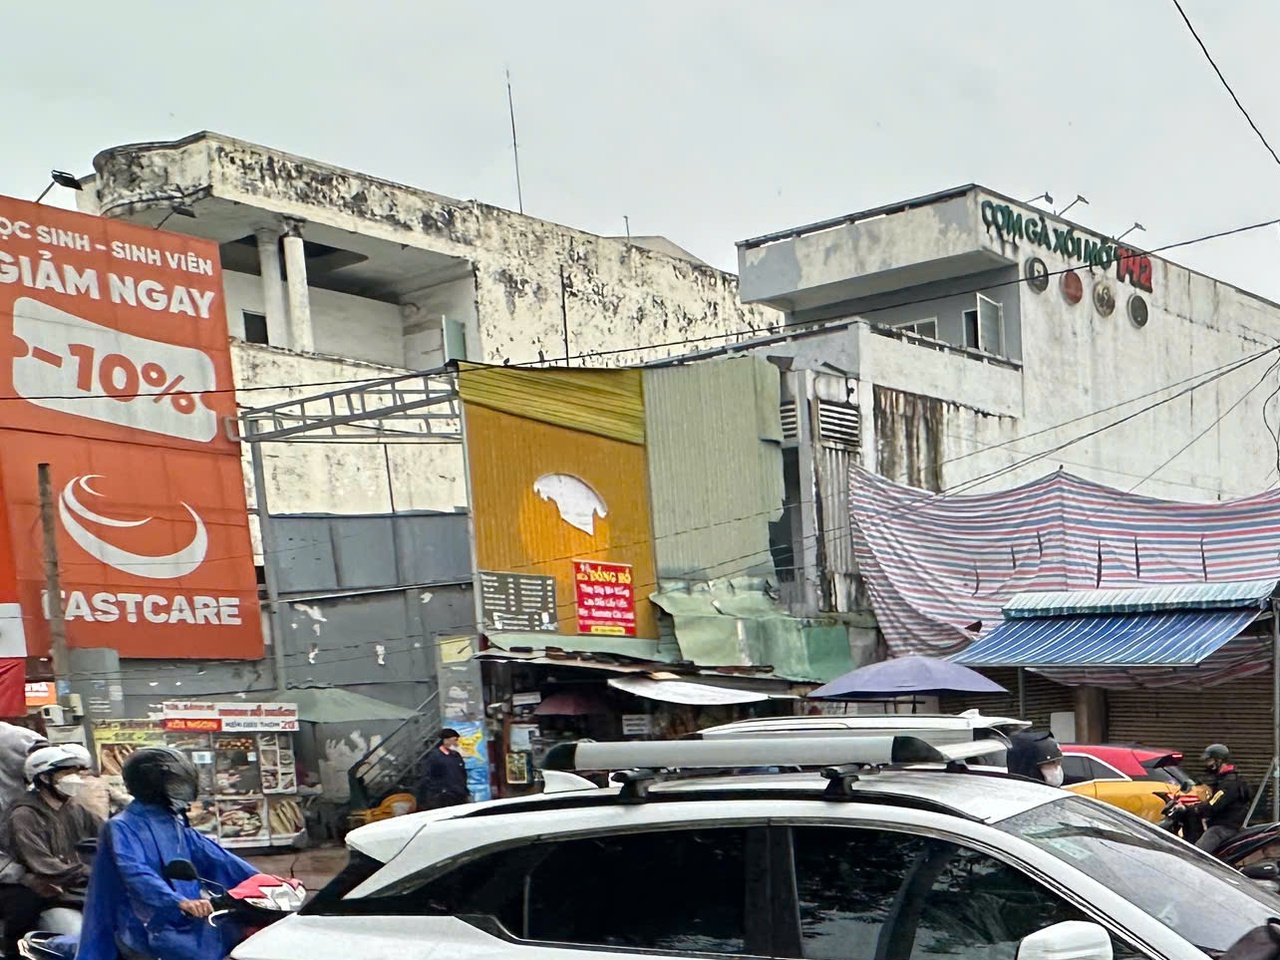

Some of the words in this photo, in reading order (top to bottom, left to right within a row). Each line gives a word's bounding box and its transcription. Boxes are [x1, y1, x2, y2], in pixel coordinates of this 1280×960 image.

[36, 225, 91, 252] SINH
[111, 240, 162, 267] SINH
[165, 251, 213, 277] VIÊN
[1025, 215, 1052, 251] GÀ
[0, 249, 101, 300] GIẢM
[108, 272, 215, 319] NGAY
[32, 343, 197, 415] -10%
